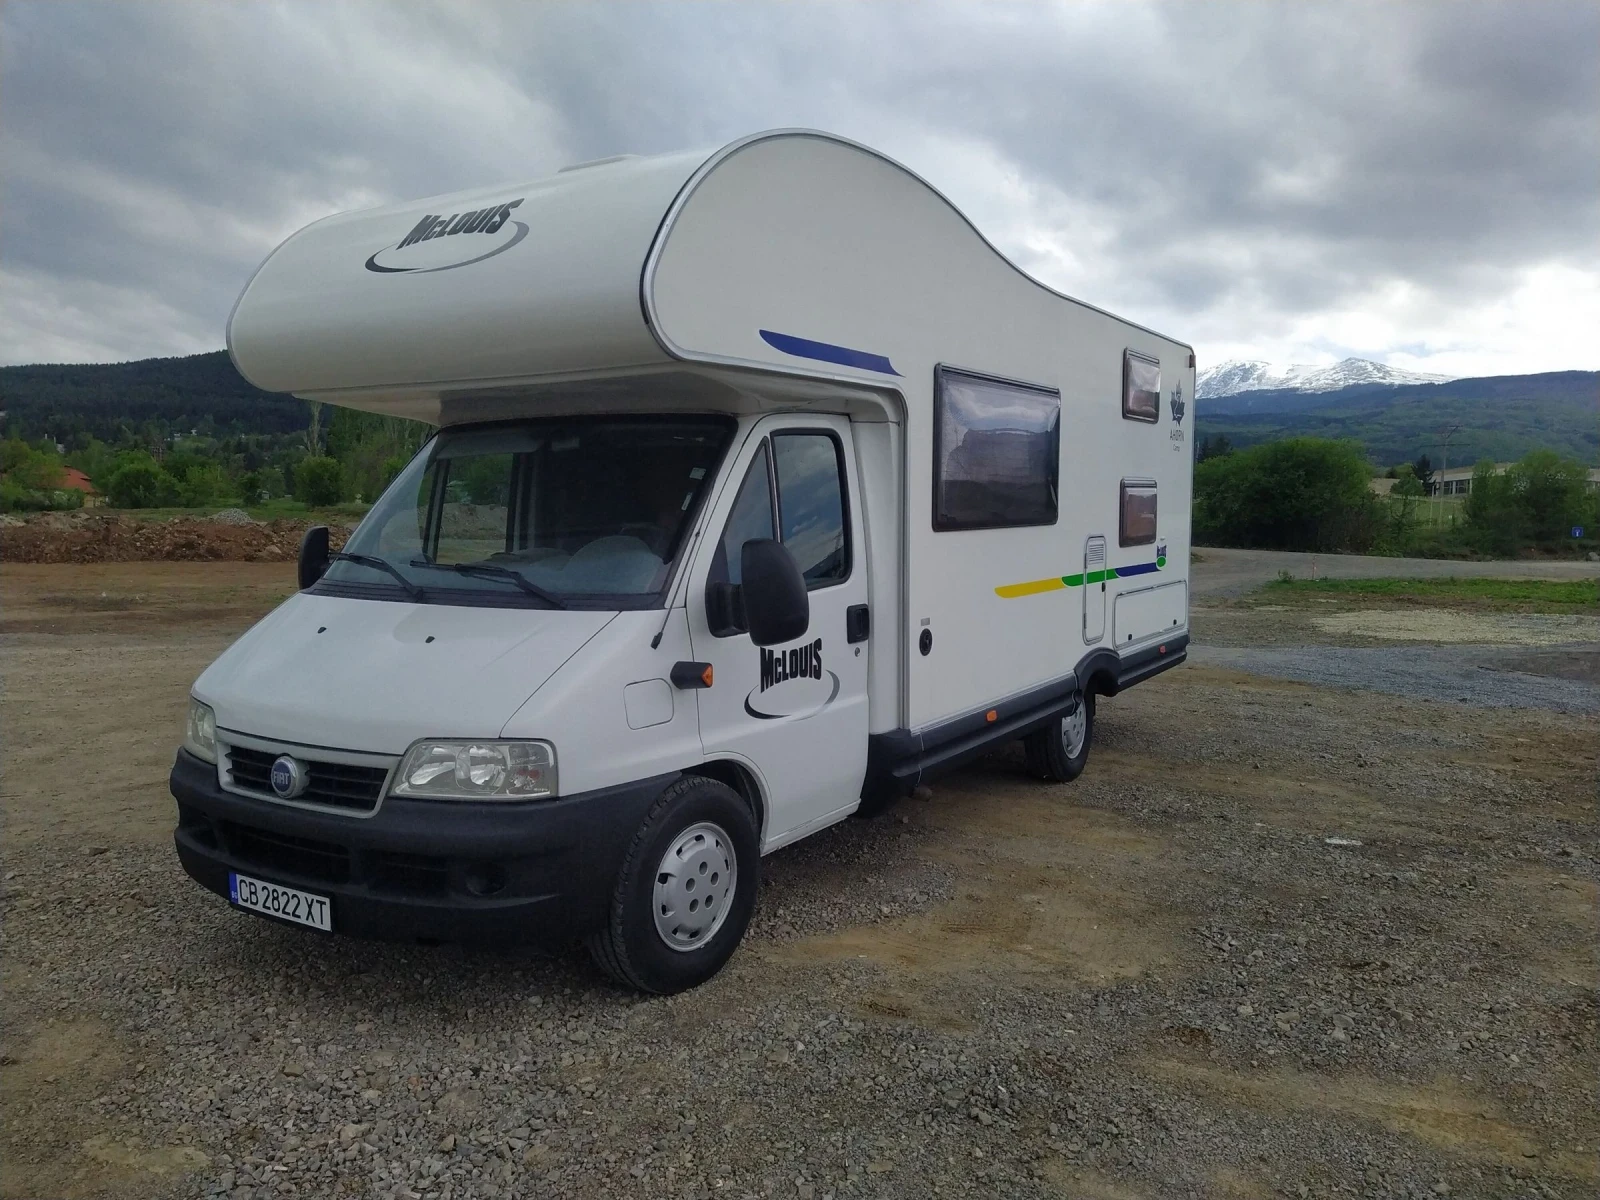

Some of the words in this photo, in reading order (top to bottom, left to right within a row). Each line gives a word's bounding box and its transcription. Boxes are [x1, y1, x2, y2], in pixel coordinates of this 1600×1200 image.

[760, 638, 823, 694] McLOUIS
[273, 770, 291, 787] FIAT
[231, 891, 239, 899] BG
[239, 879, 258, 906] CB
[261, 886, 302, 919] 2822
[305, 896, 327, 925] XT
